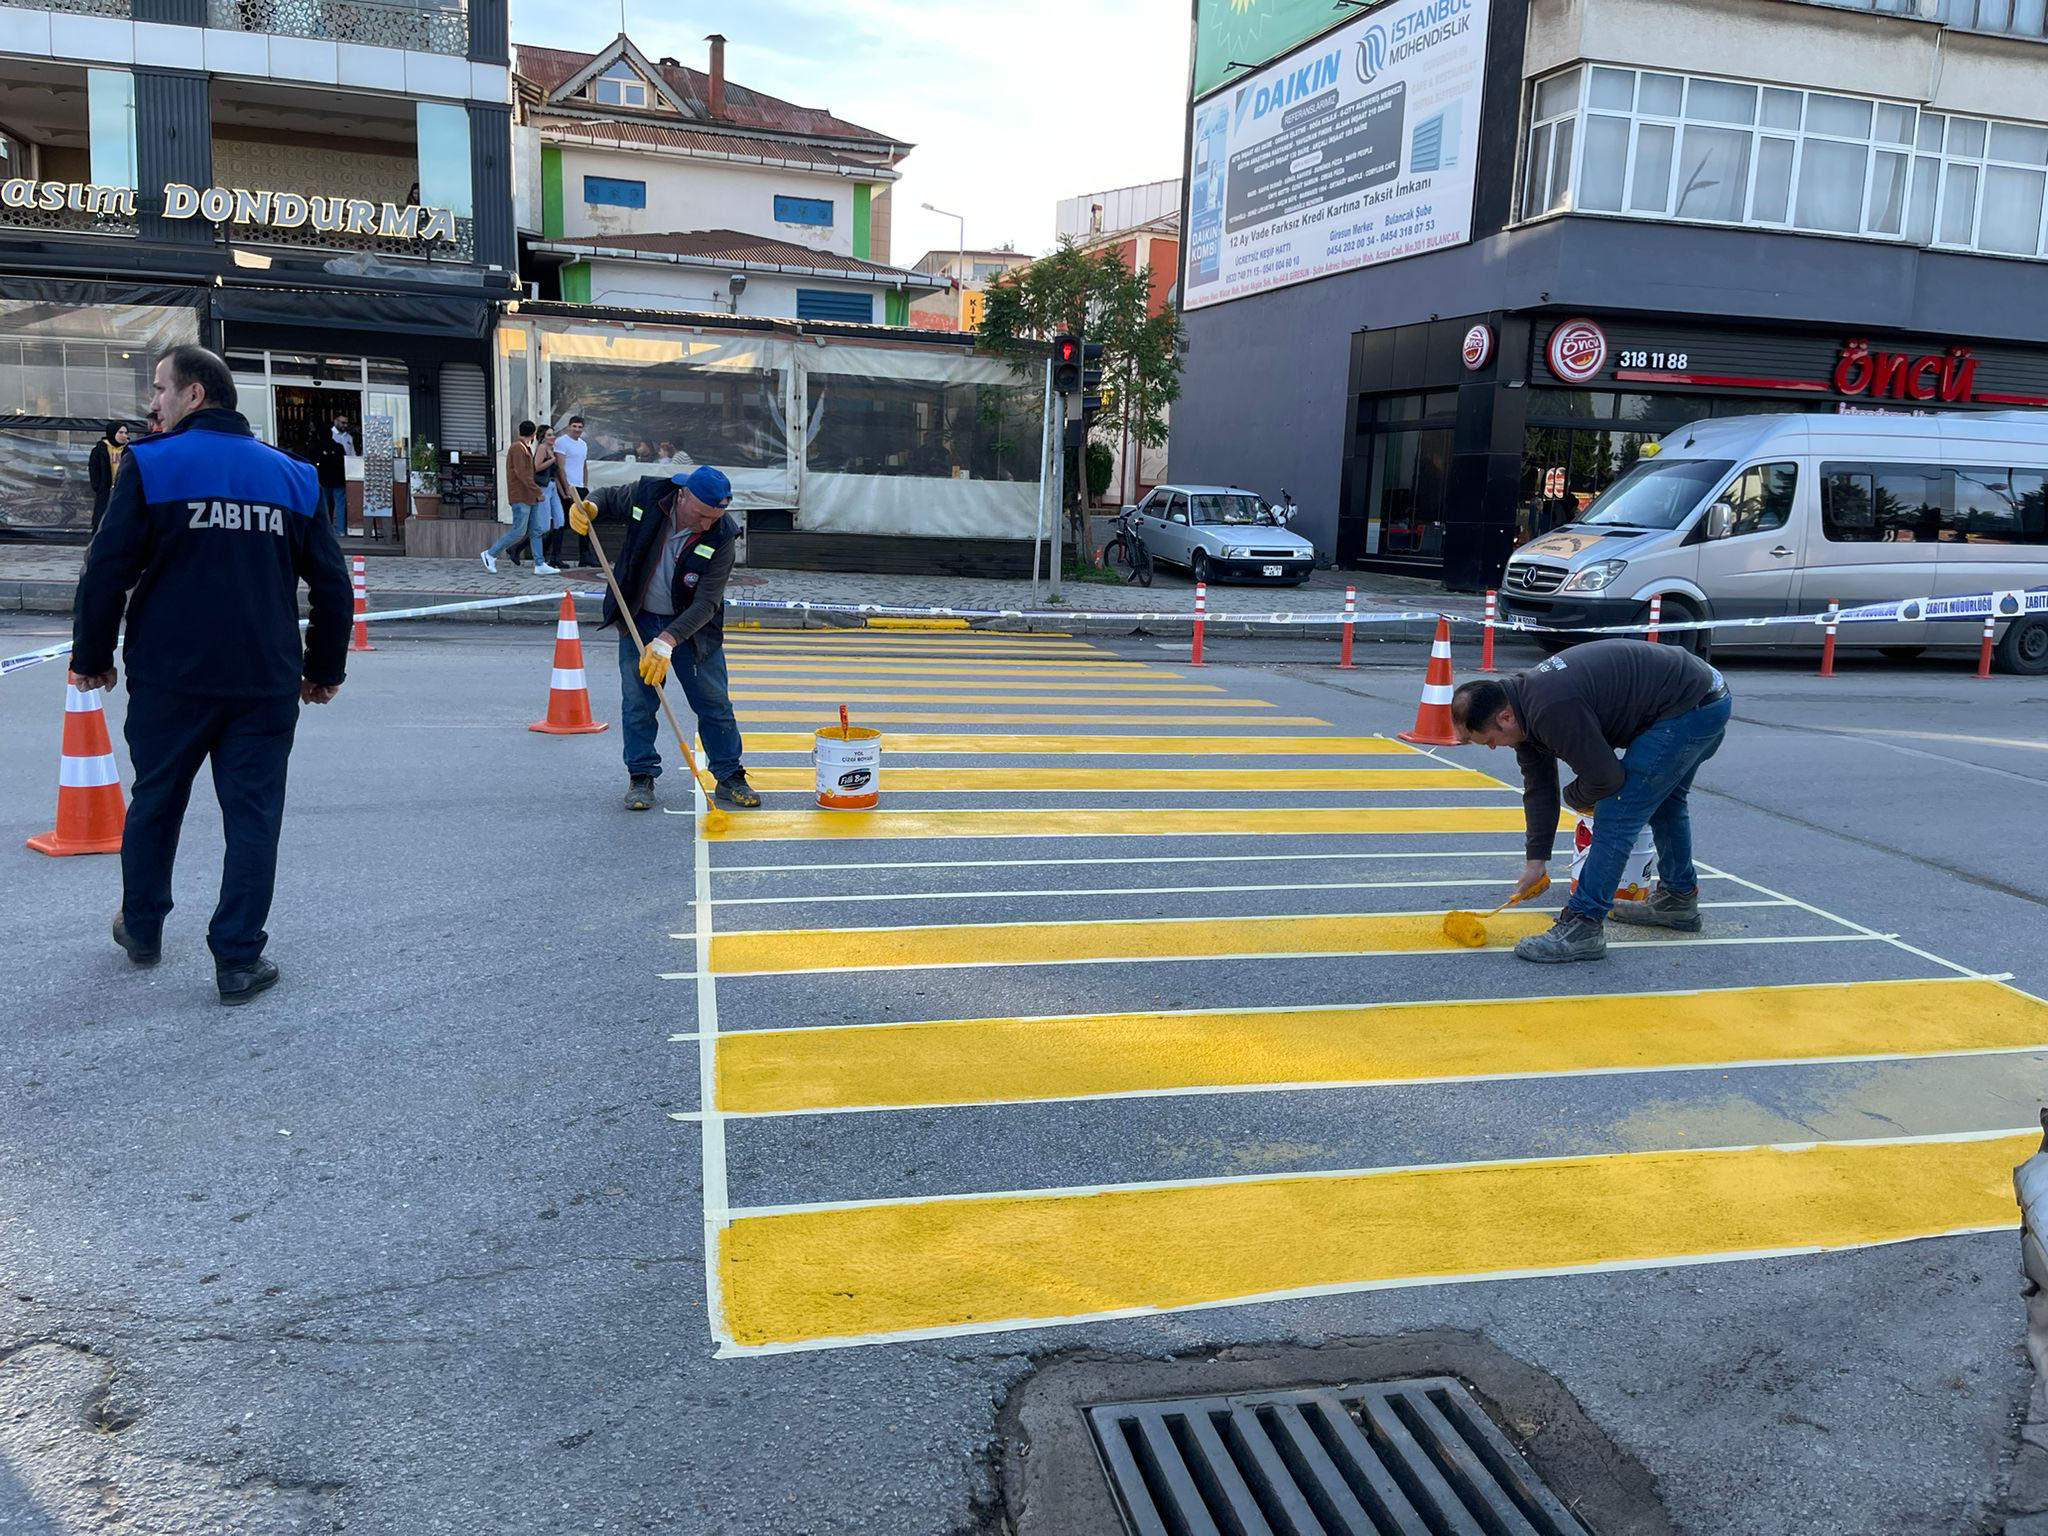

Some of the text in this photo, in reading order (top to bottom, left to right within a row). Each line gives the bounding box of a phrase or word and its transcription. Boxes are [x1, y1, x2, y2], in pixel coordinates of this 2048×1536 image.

[1253, 49, 1342, 120] DAIKIN
[161, 183, 456, 242] DONDURMA
[1240, 234, 1248, 246] Ay
[1251, 227, 1269, 240] Vade
[1271, 219, 1299, 234] Farksız
[1302, 208, 1324, 225] Kredi
[1326, 200, 1360, 217] Kartına
[1363, 188, 1393, 206] Taksit
[1384, 209, 1413, 225] Bulancak
[1329, 222, 1373, 240] Giresun Merkez
[1414, 222, 1423, 233] 07
[1425, 219, 1434, 230] 53
[1275, 242, 1290, 253] HATTI
[1620, 351, 1688, 369] 318 11 88
[187, 501, 284, 536] ZABITA
[1925, 597, 1992, 614] ZABITA MÜDÜRLÜĞÜ
